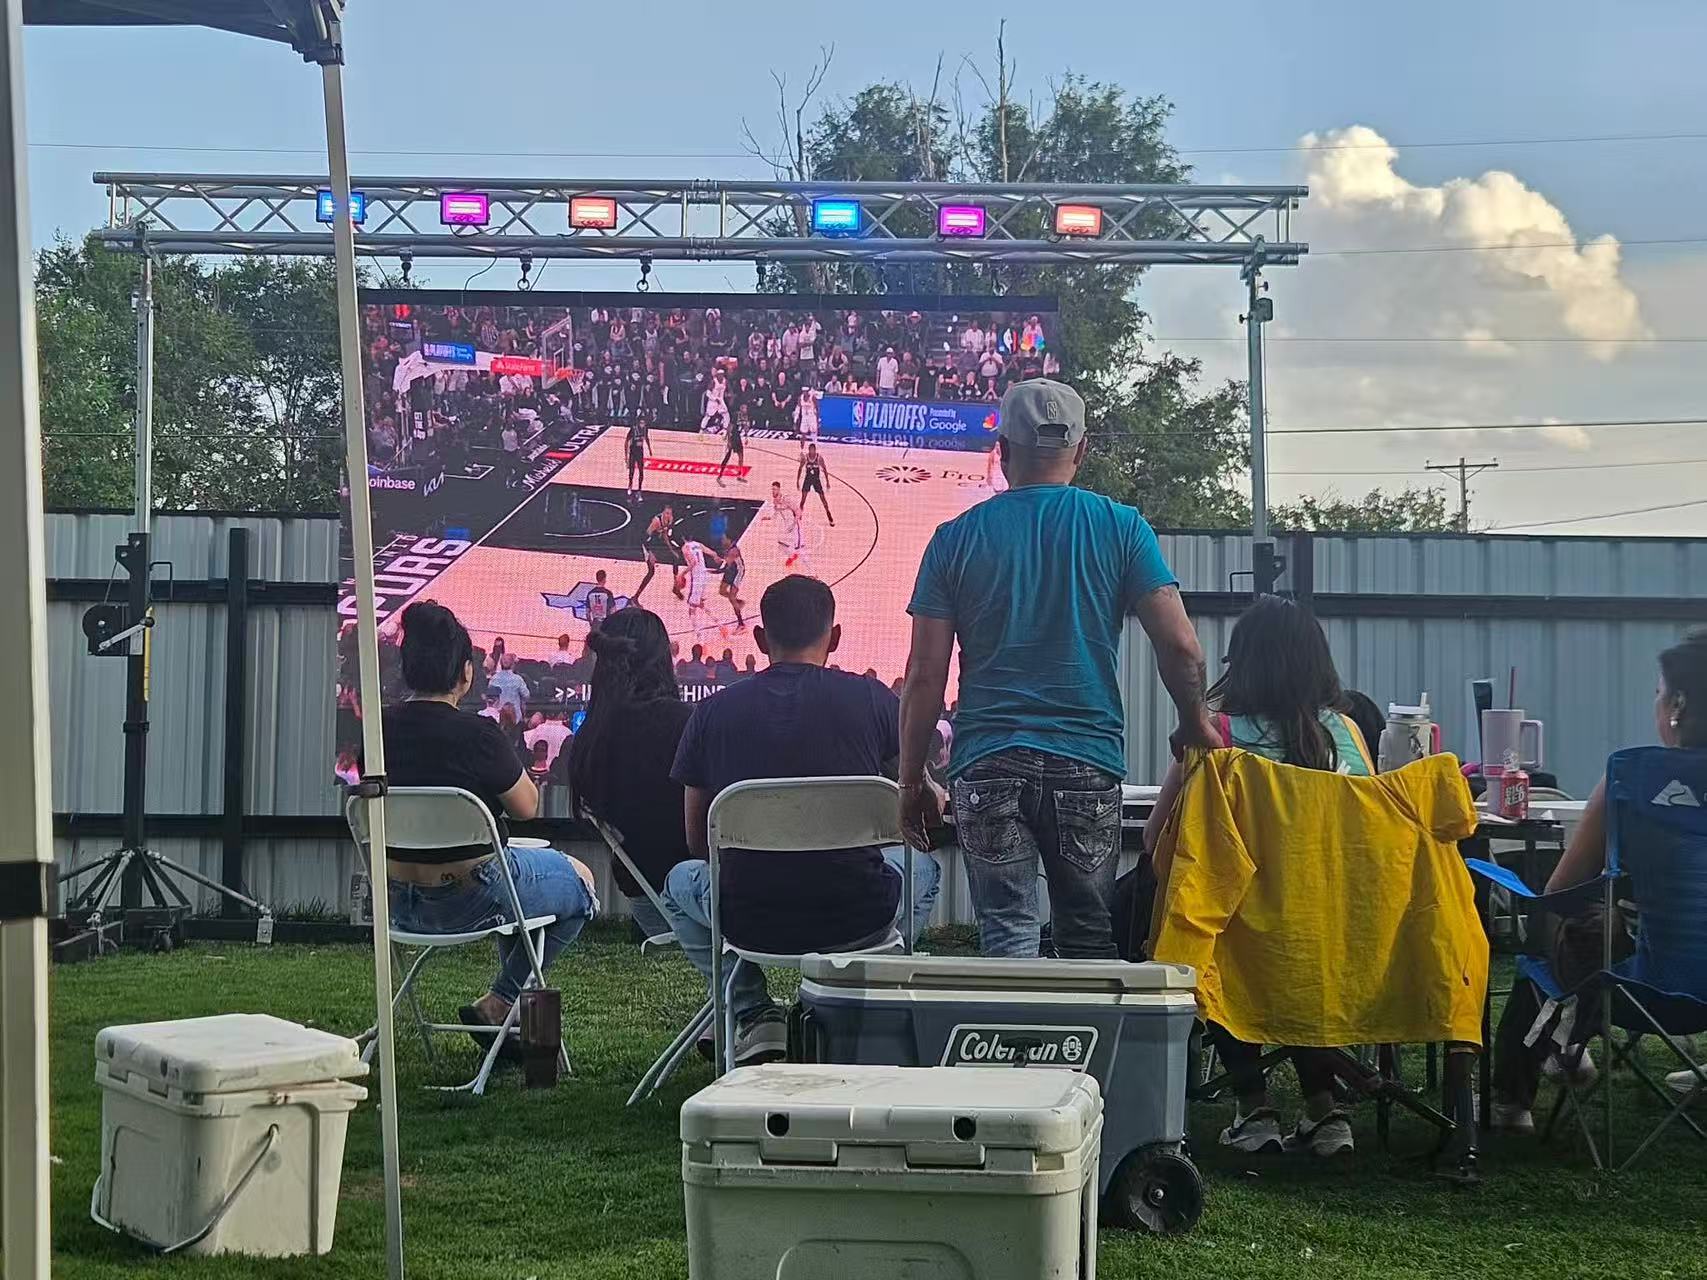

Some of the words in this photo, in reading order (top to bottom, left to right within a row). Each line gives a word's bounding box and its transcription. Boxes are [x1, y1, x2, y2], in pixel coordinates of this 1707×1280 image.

[864, 402, 928, 431] PLAYOFFS
[929, 417, 967, 433] Google
[558, 424, 605, 452] ULTRA
[369, 475, 416, 490] oinbase
